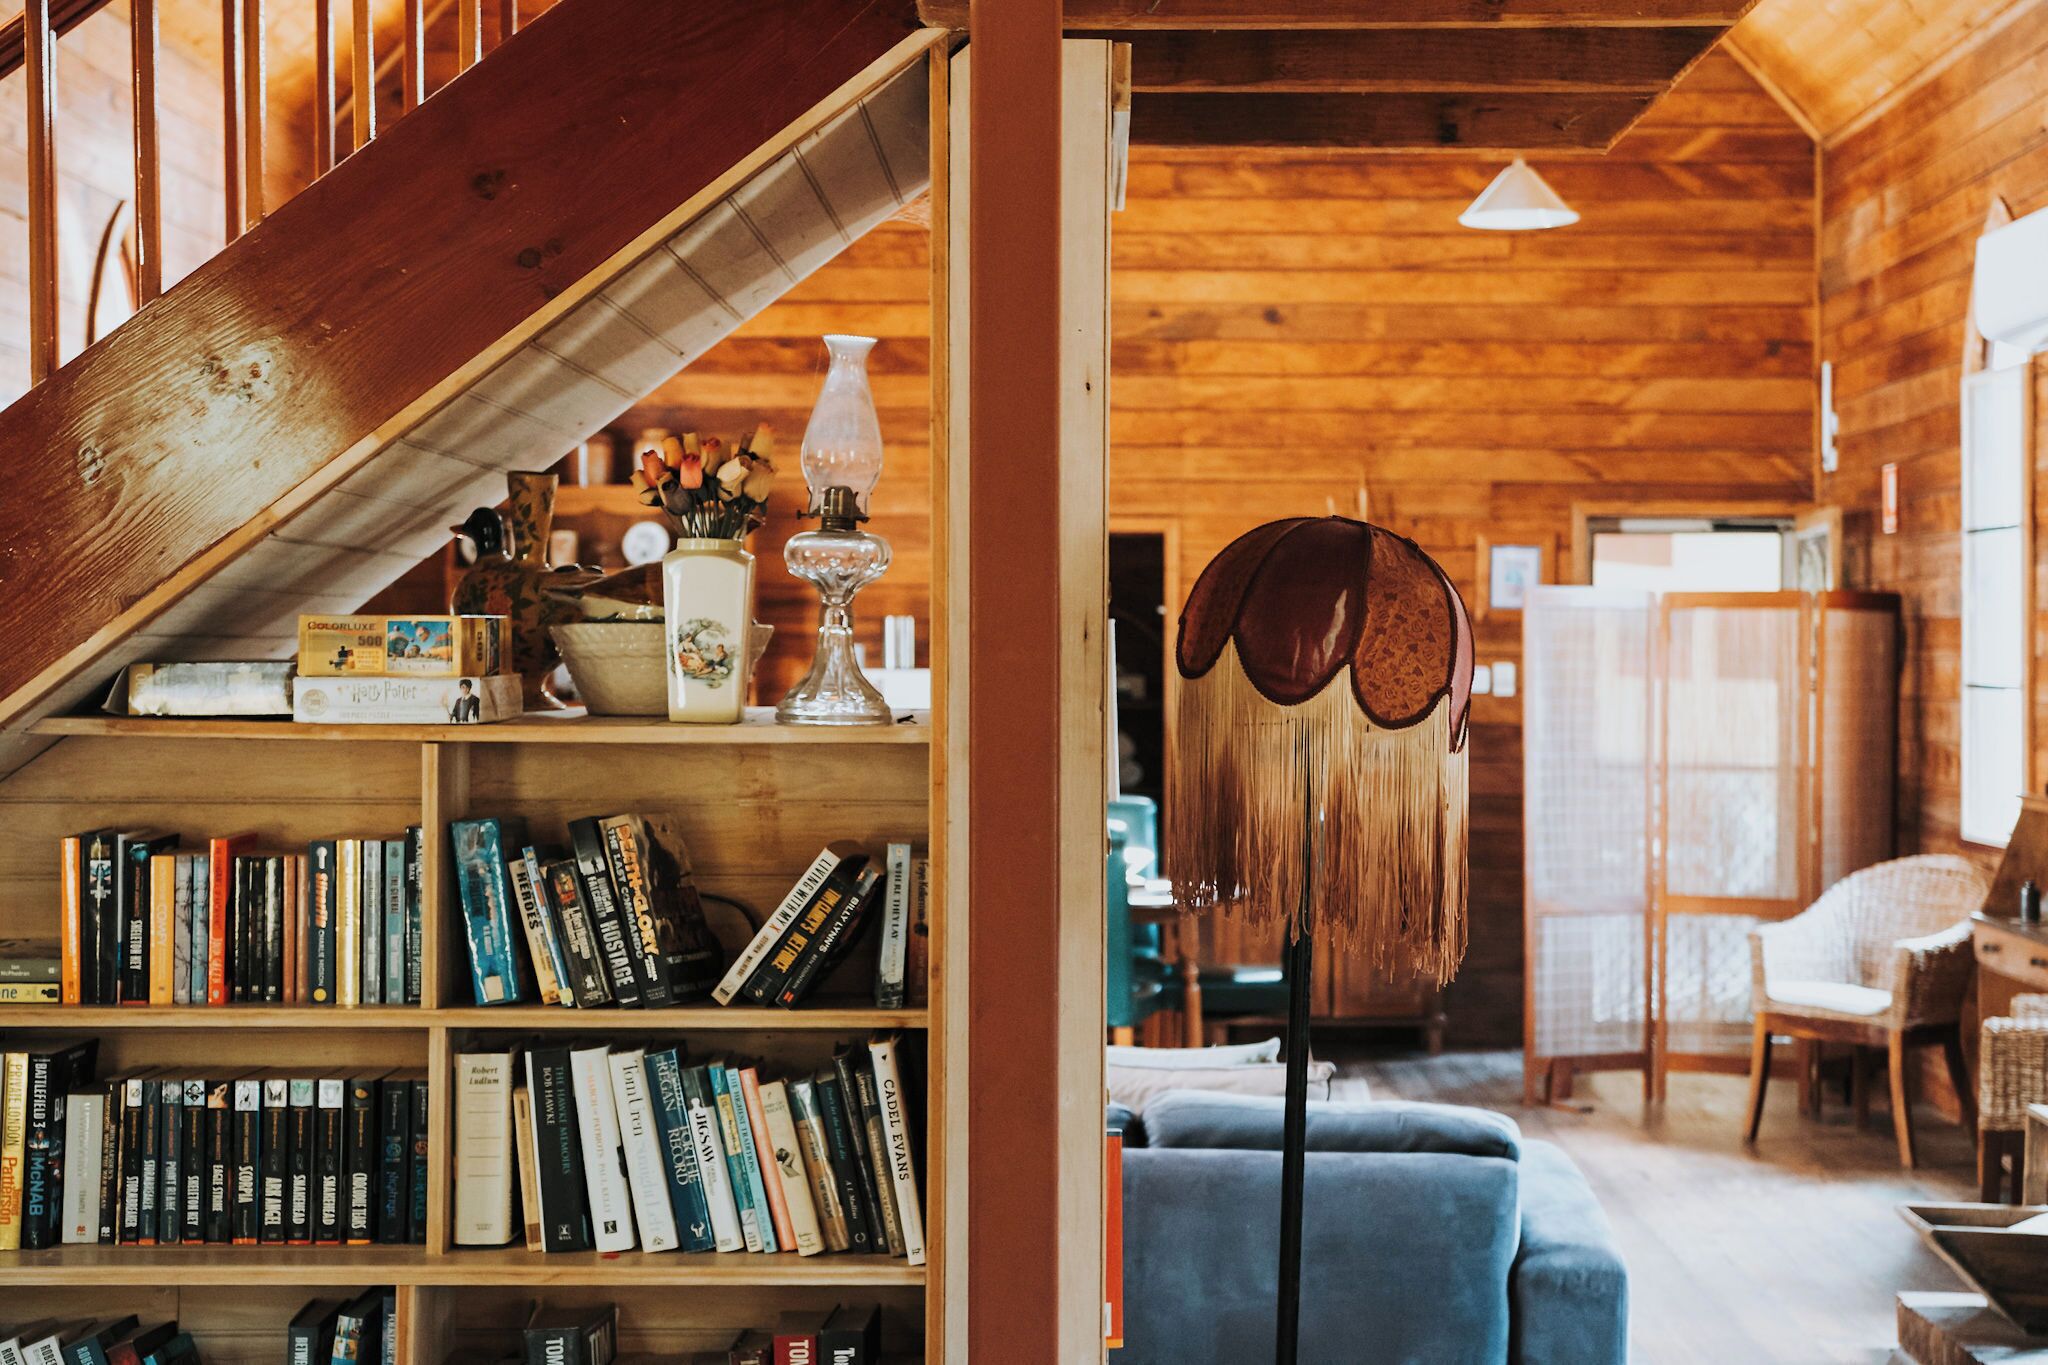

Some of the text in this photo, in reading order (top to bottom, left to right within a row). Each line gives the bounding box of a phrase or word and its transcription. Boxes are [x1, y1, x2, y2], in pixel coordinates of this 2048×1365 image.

[308, 621, 376, 631] COLORLUXE
[352, 682, 381, 703] Harry
[384, 680, 417, 704] Potter
[516, 872, 540, 931] HEROES
[586, 875, 607, 920] FALCONER
[597, 876, 616, 914] DUNCAN
[606, 827, 644, 959] THE LAST COMMANDO
[618, 824, 645, 887] DEATH
[632, 895, 660, 955] GLORY
[768, 858, 832, 934] LIVING WITH MY X
[890, 861, 904, 939] WHERE THEY LAY
[130, 919, 142, 955] SKELETON
[158, 904, 167, 945] COMFY
[818, 897, 860, 953] BILLY LYNN'S
[129, 955, 142, 970] KEY
[599, 919, 635, 988] HOSTAGE
[34, 1063, 47, 1120] BATTLEFIELD
[469, 1077, 499, 1085] Ludlum
[471, 1066, 498, 1075] Robert
[543, 1067, 555, 1125] BOB HAWKE
[622, 1060, 639, 1097] Tom
[656, 1062, 677, 1112] REGAN
[7, 1063, 23, 1146] PRIVATE LONDON
[33, 1121, 46, 1129] 3
[555, 1066, 571, 1175] THE HAWKE MEMOIRS
[729, 1073, 755, 1174] THE HIGHEST TRADITIONS
[883, 1079, 910, 1181] CADEL EVANS
[668, 1129, 689, 1186] RECORD
[679, 1125, 700, 1183] FOR THE
[695, 1113, 716, 1163] JIGSAW
[0, 1156, 18, 1226] Patterson
[29, 1157, 44, 1216] McNAB
[142, 1159, 155, 1211] STORMBREAKER
[165, 1160, 177, 1186] POINT
[212, 1164, 224, 1212] EAGLE STRIKE
[238, 1165, 253, 1204] SCORPIA
[12, 1187, 21, 1217] James
[125, 1175, 138, 1228] STORMBREAKER
[187, 1175, 199, 1226] SKELETON KEY
[264, 1177, 282, 1226] ARK ANGEL
[292, 1174, 306, 1225] SNAKEHEAD
[322, 1175, 336, 1226] SNAKEHEAD
[351, 1172, 367, 1230] CROCODILE TEARS
[40, 1344, 58, 1365] ROBE
[833, 1347, 856, 1365] To
